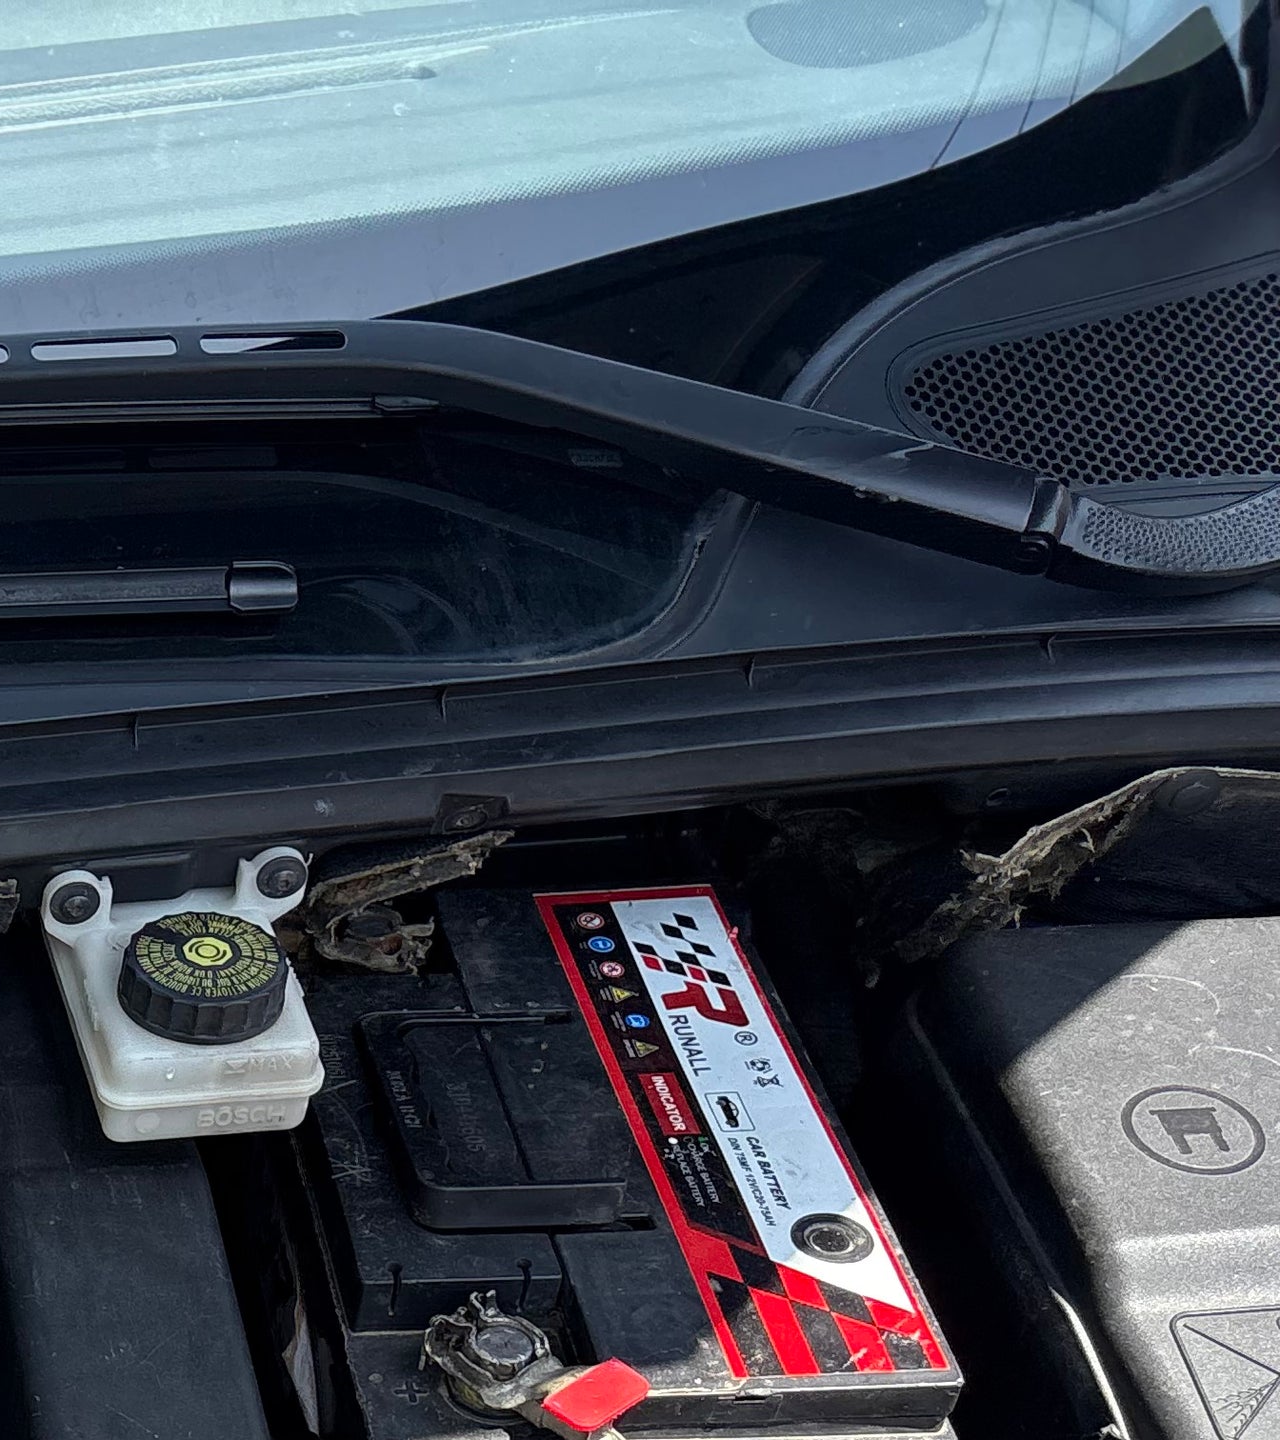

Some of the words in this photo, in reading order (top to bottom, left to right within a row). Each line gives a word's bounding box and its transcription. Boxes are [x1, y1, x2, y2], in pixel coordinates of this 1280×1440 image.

[191, 986, 201, 996] CE
[205, 982, 248, 997] NETTOYER
[668, 1015, 711, 1076] RUNALL
[250, 1056, 294, 1072] MAX
[196, 1105, 286, 1129] BOSCH
[651, 1076, 687, 1131] INDICATOR
[728, 1137, 741, 1151] DIN
[746, 1136, 766, 1159] CAR
[757, 1159, 791, 1210] BATTERY
[685, 1176, 704, 1207] BATTERY
[700, 1172, 720, 1203] BATTERY
